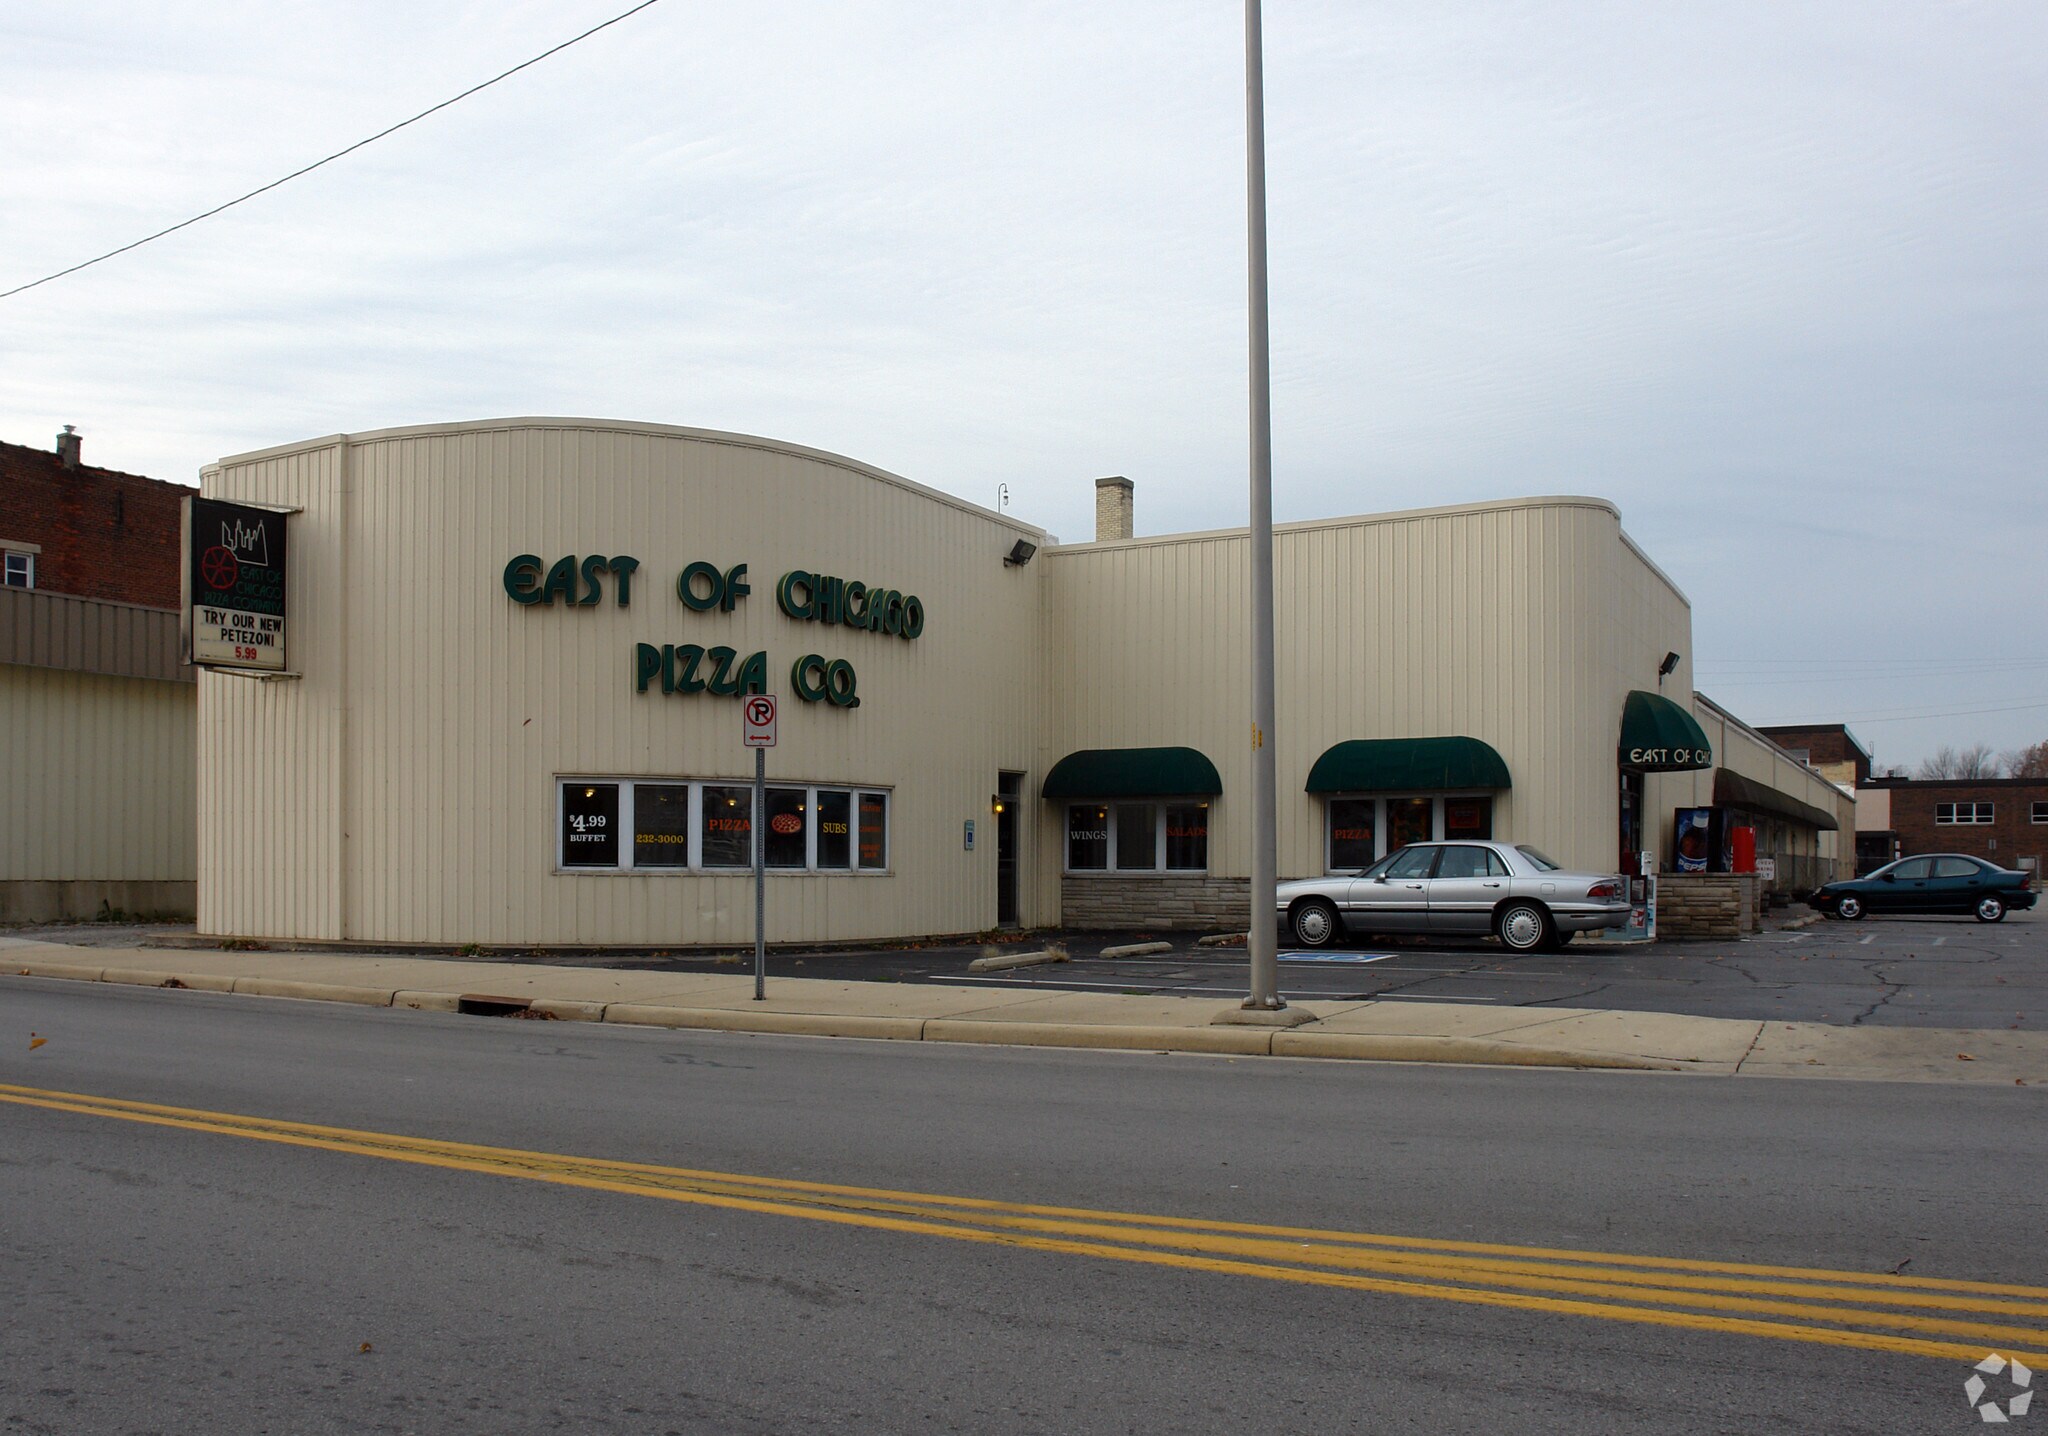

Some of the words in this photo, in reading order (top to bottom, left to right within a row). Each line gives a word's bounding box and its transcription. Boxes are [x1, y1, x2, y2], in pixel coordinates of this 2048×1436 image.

[240, 566, 264, 581] EAST
[236, 581, 282, 600] CHICAGO
[503, 554, 640, 607] EAST
[677, 561, 751, 612] OF
[776, 569, 925, 640] CHICAGO
[205, 591, 229, 606] PIZZA
[232, 595, 282, 614] COMPANY
[203, 609, 227, 625] TRY
[232, 614, 255, 629] OUR
[260, 617, 282, 632] NEW
[221, 628, 274, 647] PETEZONI
[235, 646, 257, 660] 5.99
[636, 642, 767, 697] PIZZA
[1630, 748, 1668, 763] EAST
[1673, 748, 1691, 763] OF
[569, 814, 606, 832] $4.99
[708, 818, 751, 831] PIZZA
[822, 822, 847, 835] SUBS
[570, 834, 606, 843] BUFFET
[636, 833, 684, 844] 232-3000
[1070, 830, 1107, 840] WINGS
[1166, 825, 1208, 837] SALADS
[1334, 829, 1371, 840] PIZZA
